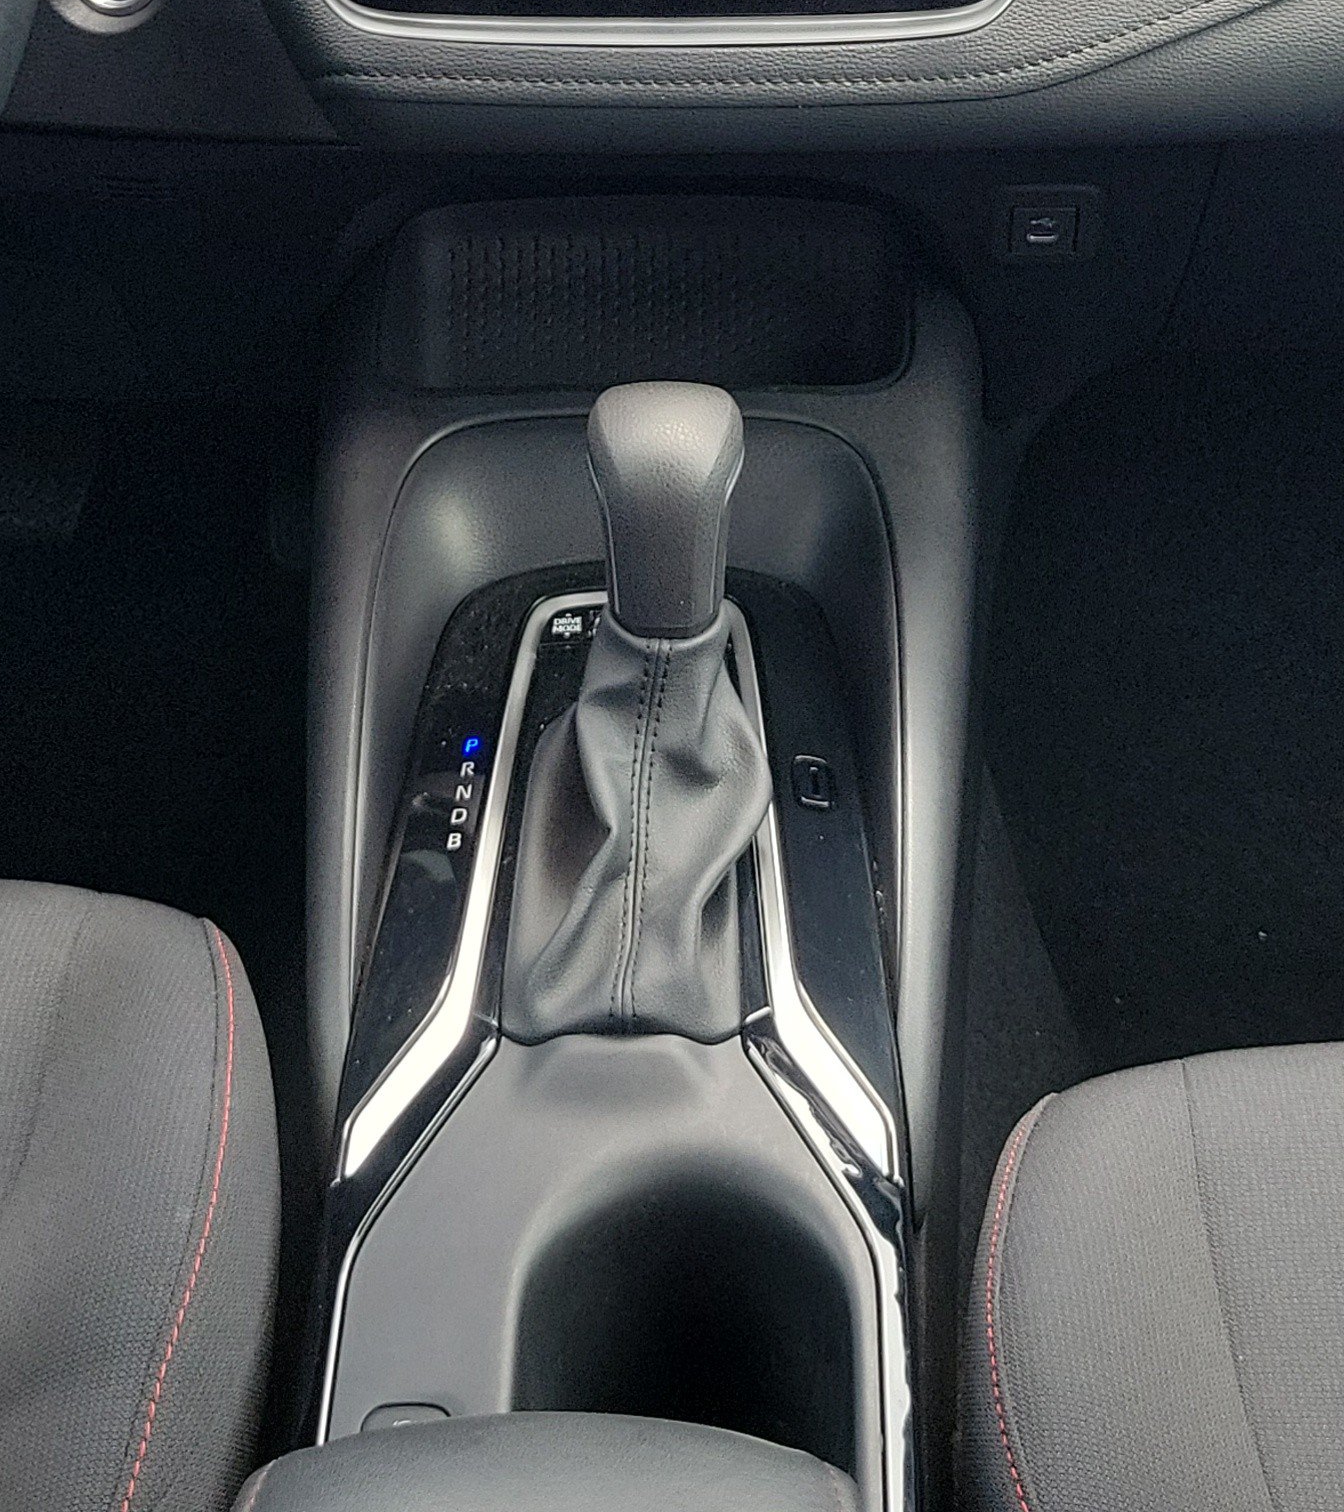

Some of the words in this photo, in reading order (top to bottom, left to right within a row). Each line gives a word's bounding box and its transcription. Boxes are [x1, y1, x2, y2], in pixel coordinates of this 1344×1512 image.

[553, 616, 582, 625] DRIVE
[464, 738, 478, 753] P
[460, 761, 474, 777] R
[456, 784, 472, 801] N
[450, 808, 467, 824] D
[447, 832, 461, 850] B
